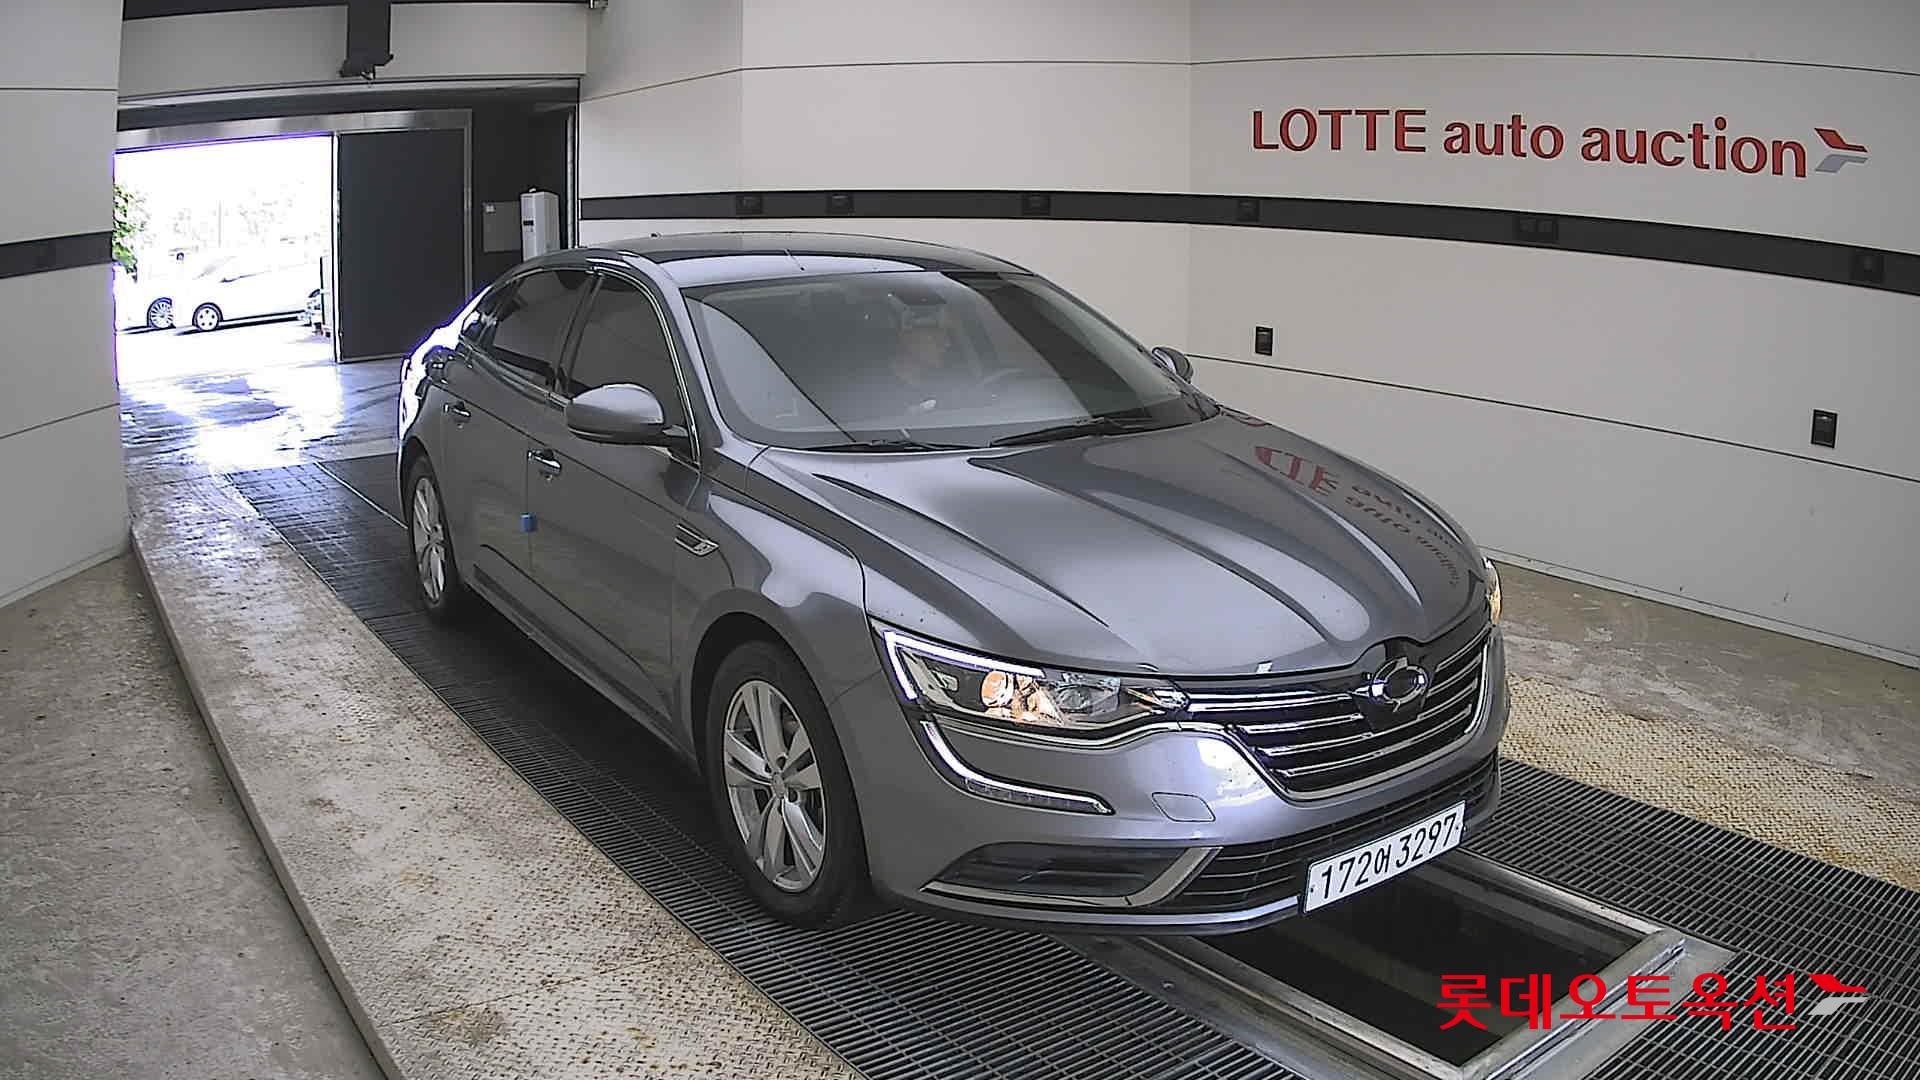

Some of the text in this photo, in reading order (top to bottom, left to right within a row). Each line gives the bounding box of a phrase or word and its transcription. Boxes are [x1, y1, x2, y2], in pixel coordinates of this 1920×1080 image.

[1253, 109, 1807, 177] LOTTE auto auction
